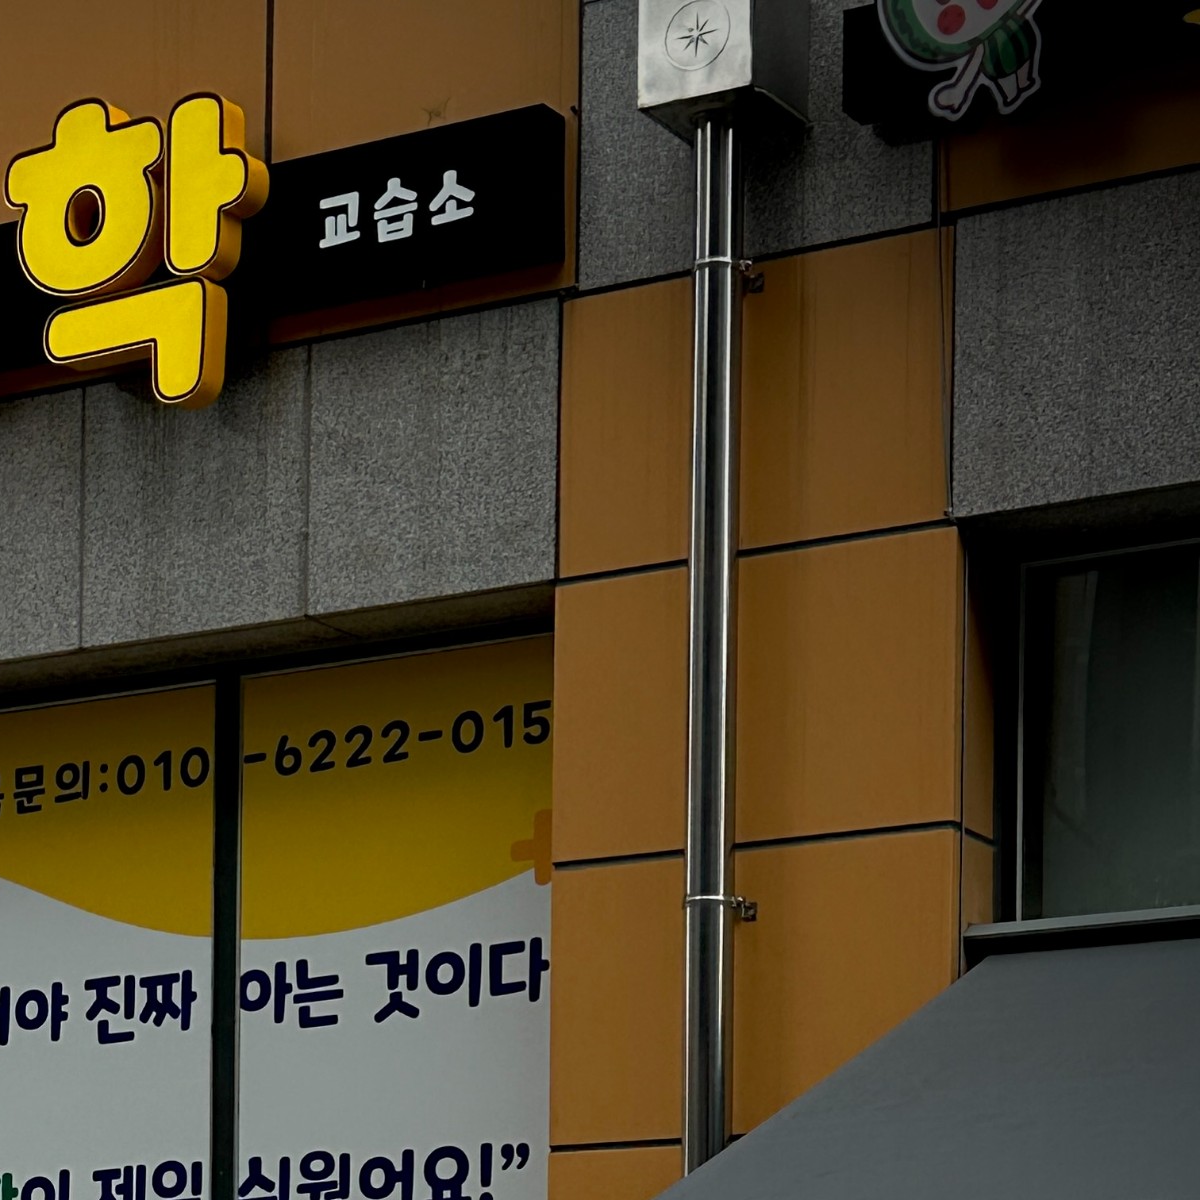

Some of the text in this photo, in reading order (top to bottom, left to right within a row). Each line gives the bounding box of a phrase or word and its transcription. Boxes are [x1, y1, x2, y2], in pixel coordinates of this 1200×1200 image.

[318, 169, 476, 249] 교습소
[85, 970, 197, 1044] 진짜
[240, 959, 344, 1028] 아는
[365, 937, 550, 1023] 것이다
